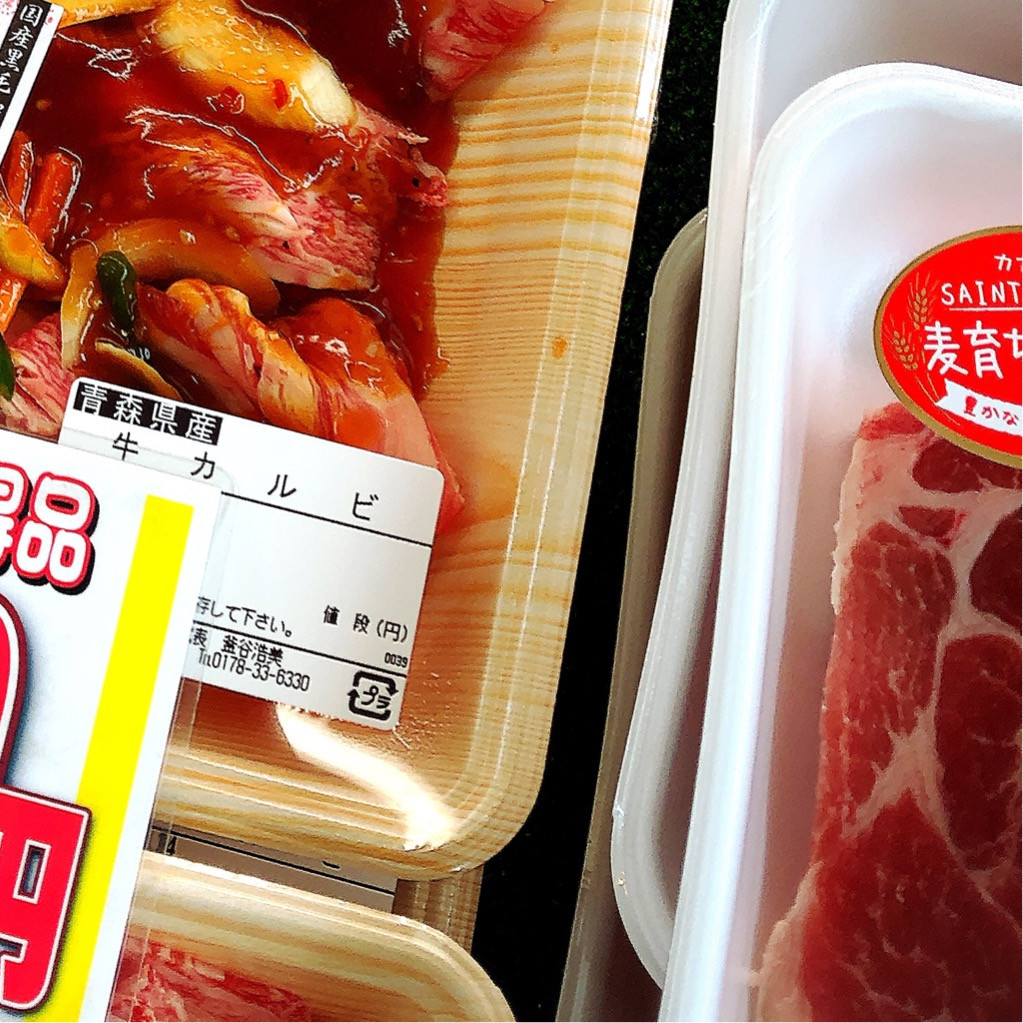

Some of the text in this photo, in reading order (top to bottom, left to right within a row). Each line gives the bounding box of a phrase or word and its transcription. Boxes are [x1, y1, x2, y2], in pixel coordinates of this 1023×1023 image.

[74, 382, 223, 445] 青森県産
[962, 394, 1020, 427] 豊かな
[385, 652, 408, 668] 0039
